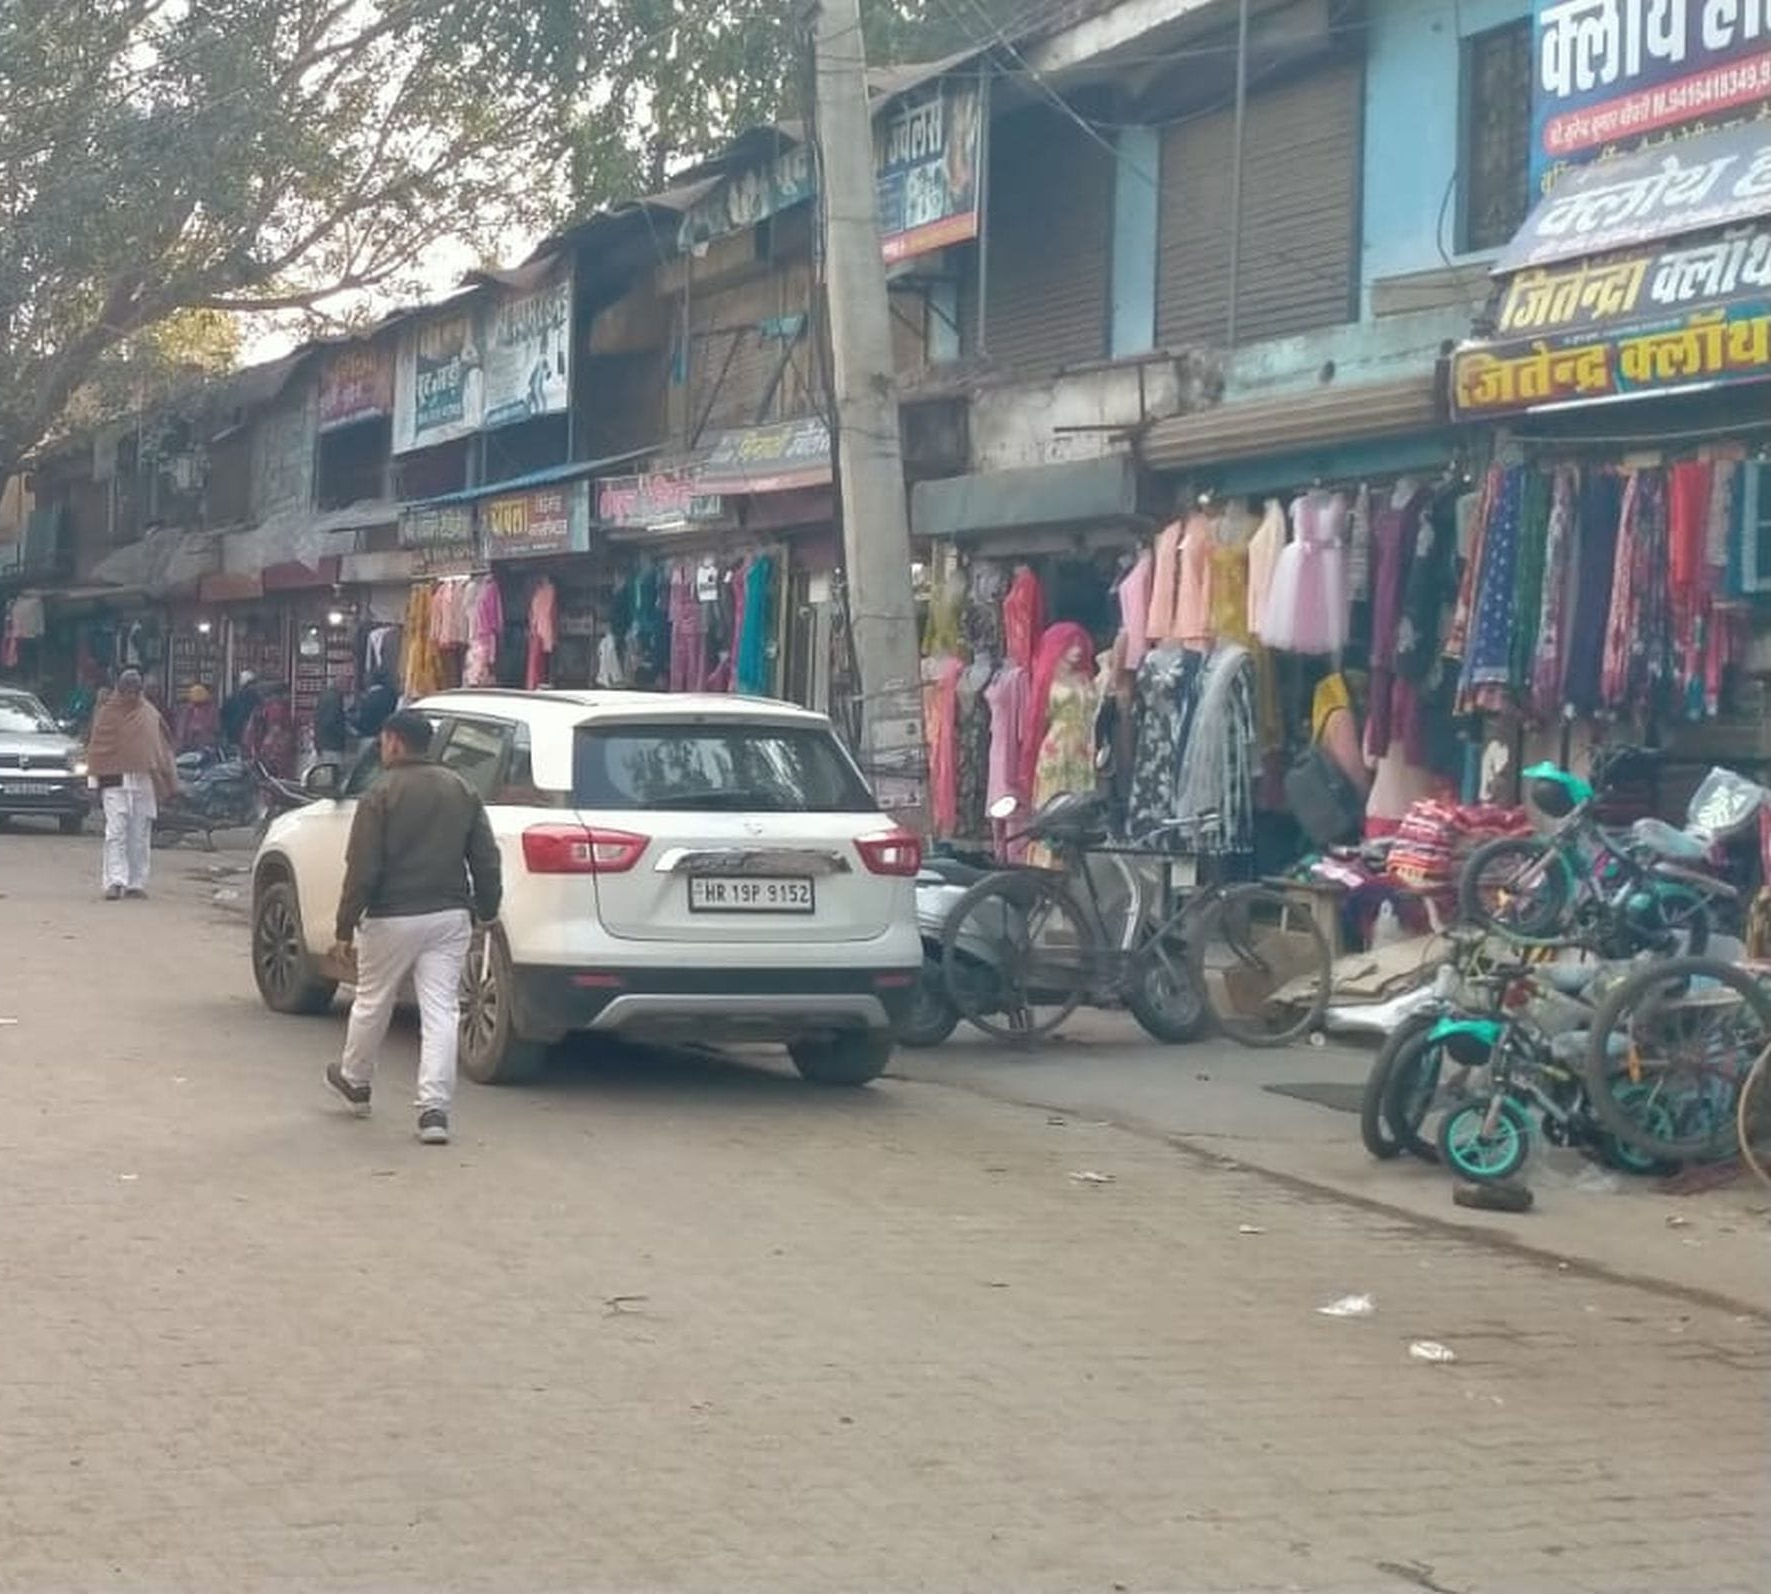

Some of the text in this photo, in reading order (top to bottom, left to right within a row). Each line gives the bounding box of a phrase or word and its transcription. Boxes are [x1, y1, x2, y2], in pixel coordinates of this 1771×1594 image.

[705, 884, 809, 903] HR 19P 9152
